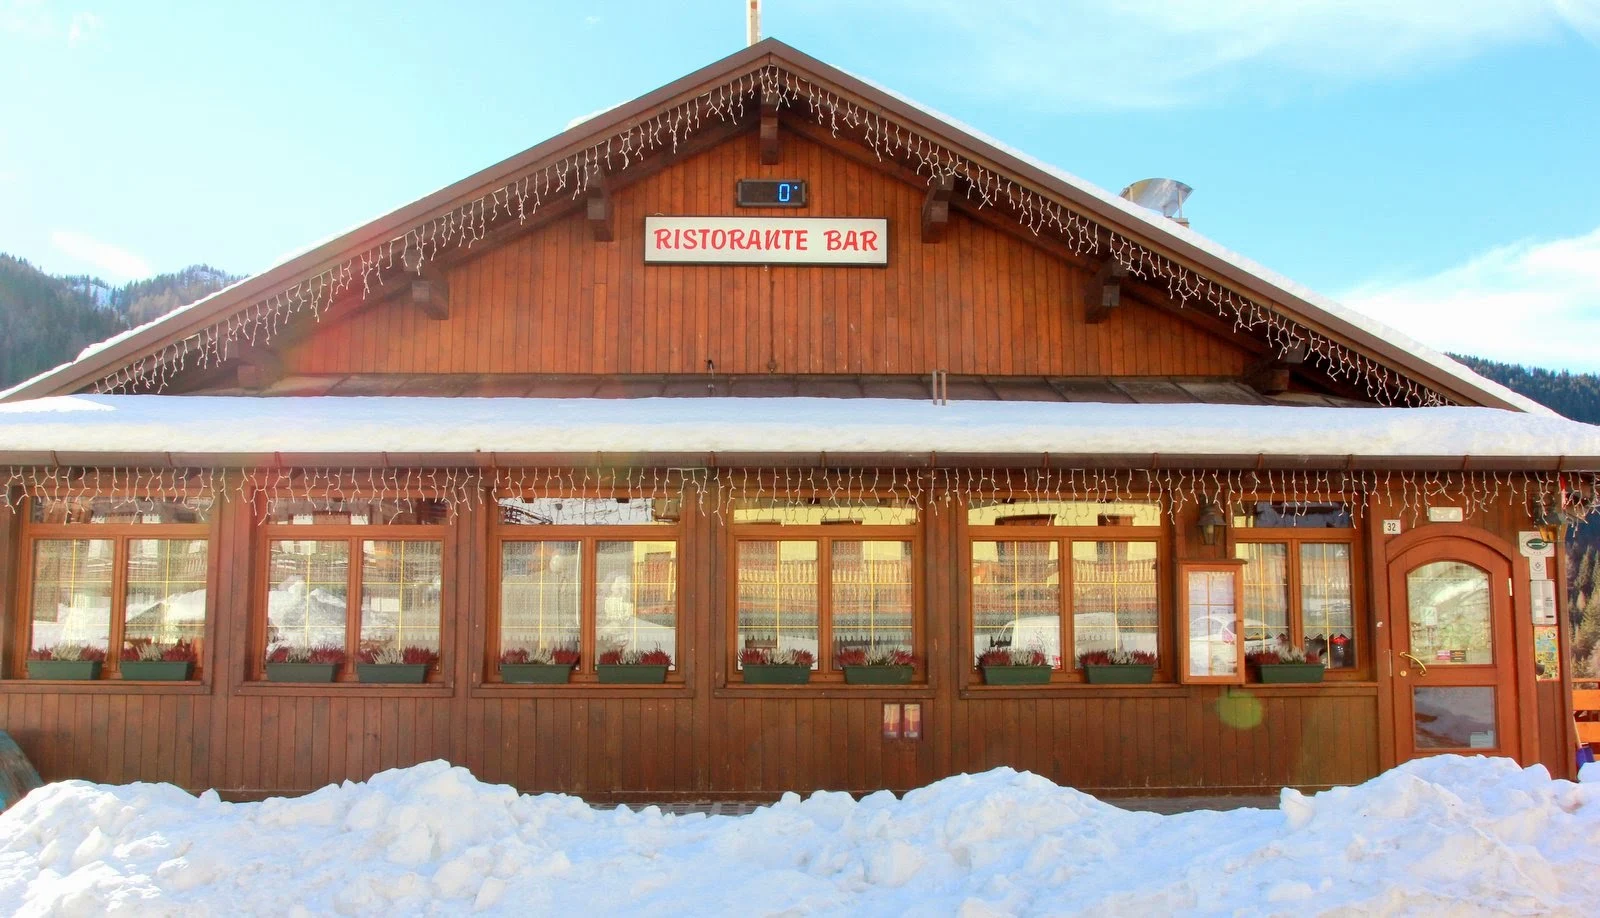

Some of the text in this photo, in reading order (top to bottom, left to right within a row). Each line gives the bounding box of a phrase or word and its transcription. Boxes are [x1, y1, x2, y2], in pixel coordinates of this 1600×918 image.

[654, 228, 878, 252] RISTORANTE BAR
[1387, 522, 1396, 532] 32
